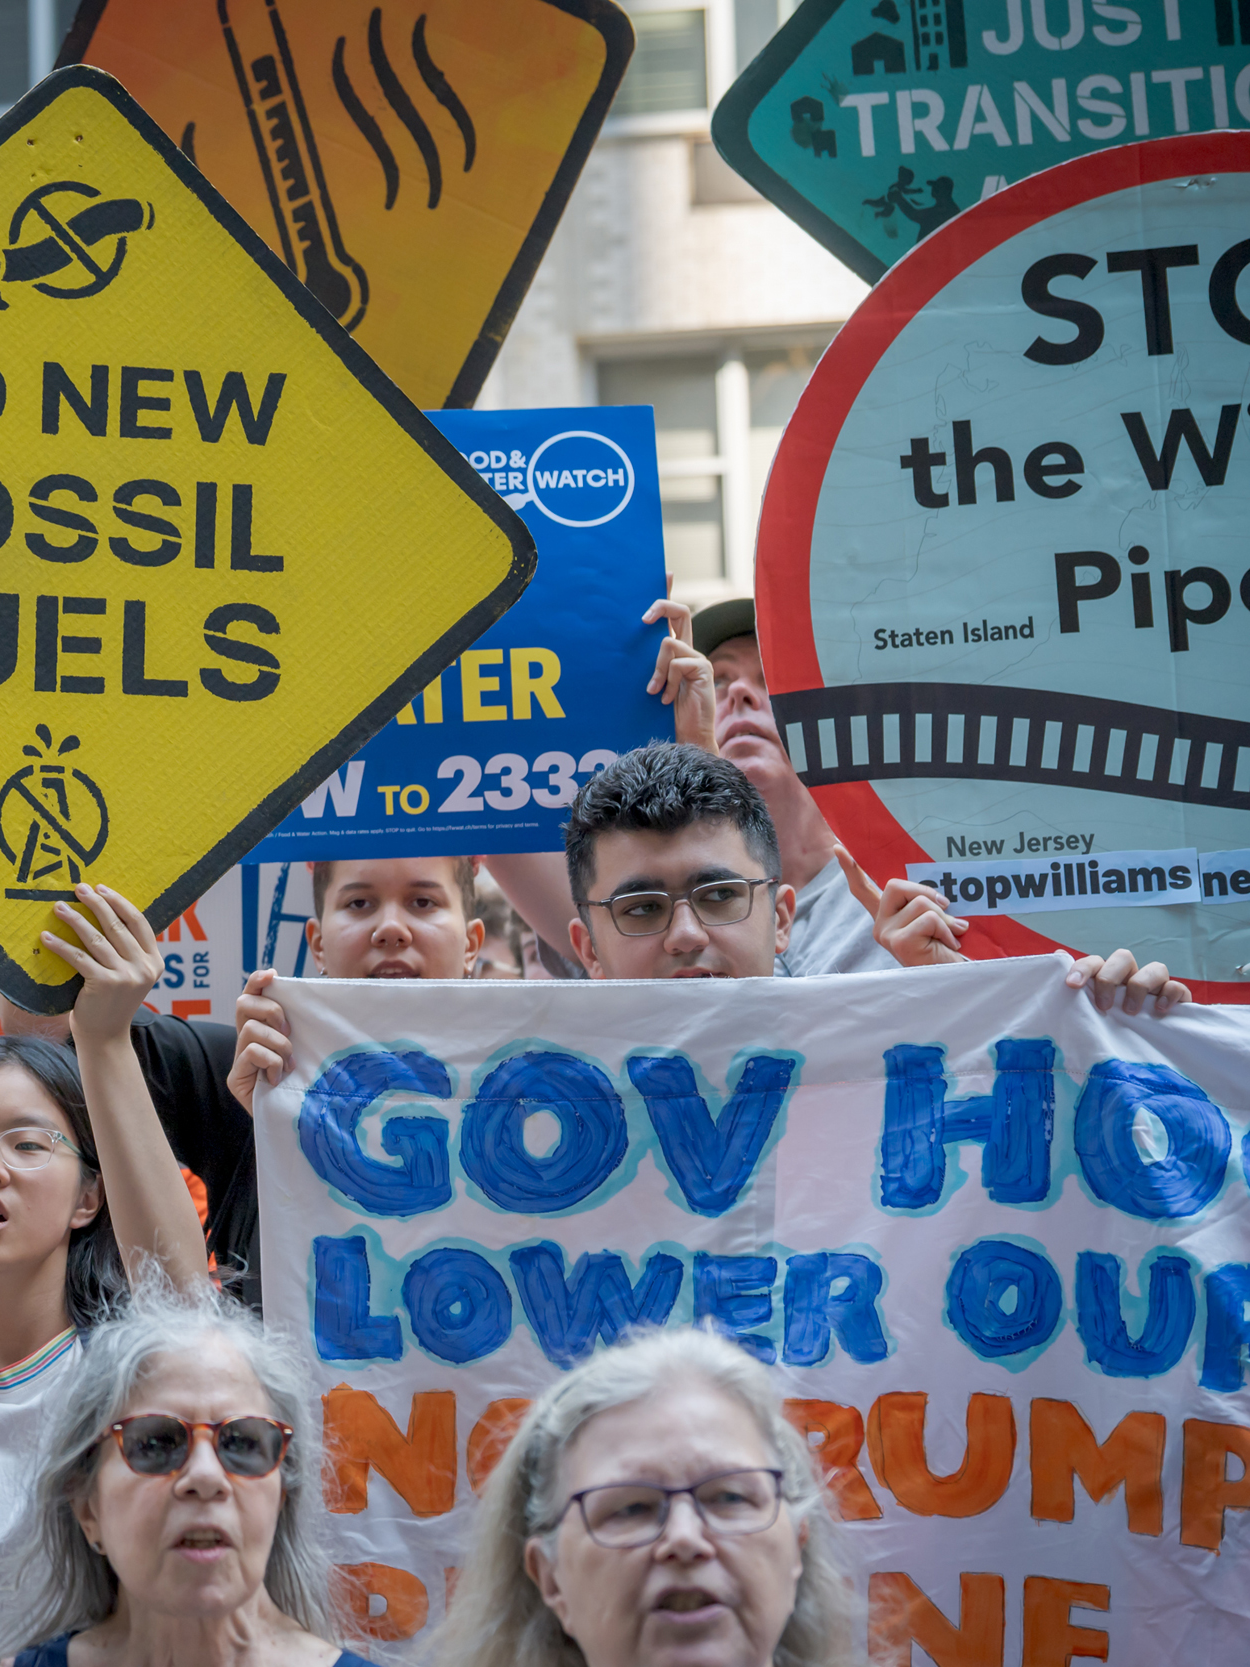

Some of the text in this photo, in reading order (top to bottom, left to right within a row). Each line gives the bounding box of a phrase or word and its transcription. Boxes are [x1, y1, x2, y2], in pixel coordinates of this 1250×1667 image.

[839, 63, 1250, 157] TRANSITI
[41, 361, 287, 446] NEW
[509, 450, 527, 469] &
[535, 468, 625, 489] WATCH
[899, 420, 1085, 509] the
[873, 616, 1035, 650] Staten Island
[377, 784, 430, 815] TO
[946, 832, 1095, 857] New Jersey
[193, 951, 210, 989] FOR
[298, 1046, 797, 1218] GOV
[312, 1234, 890, 1370] LOWER
